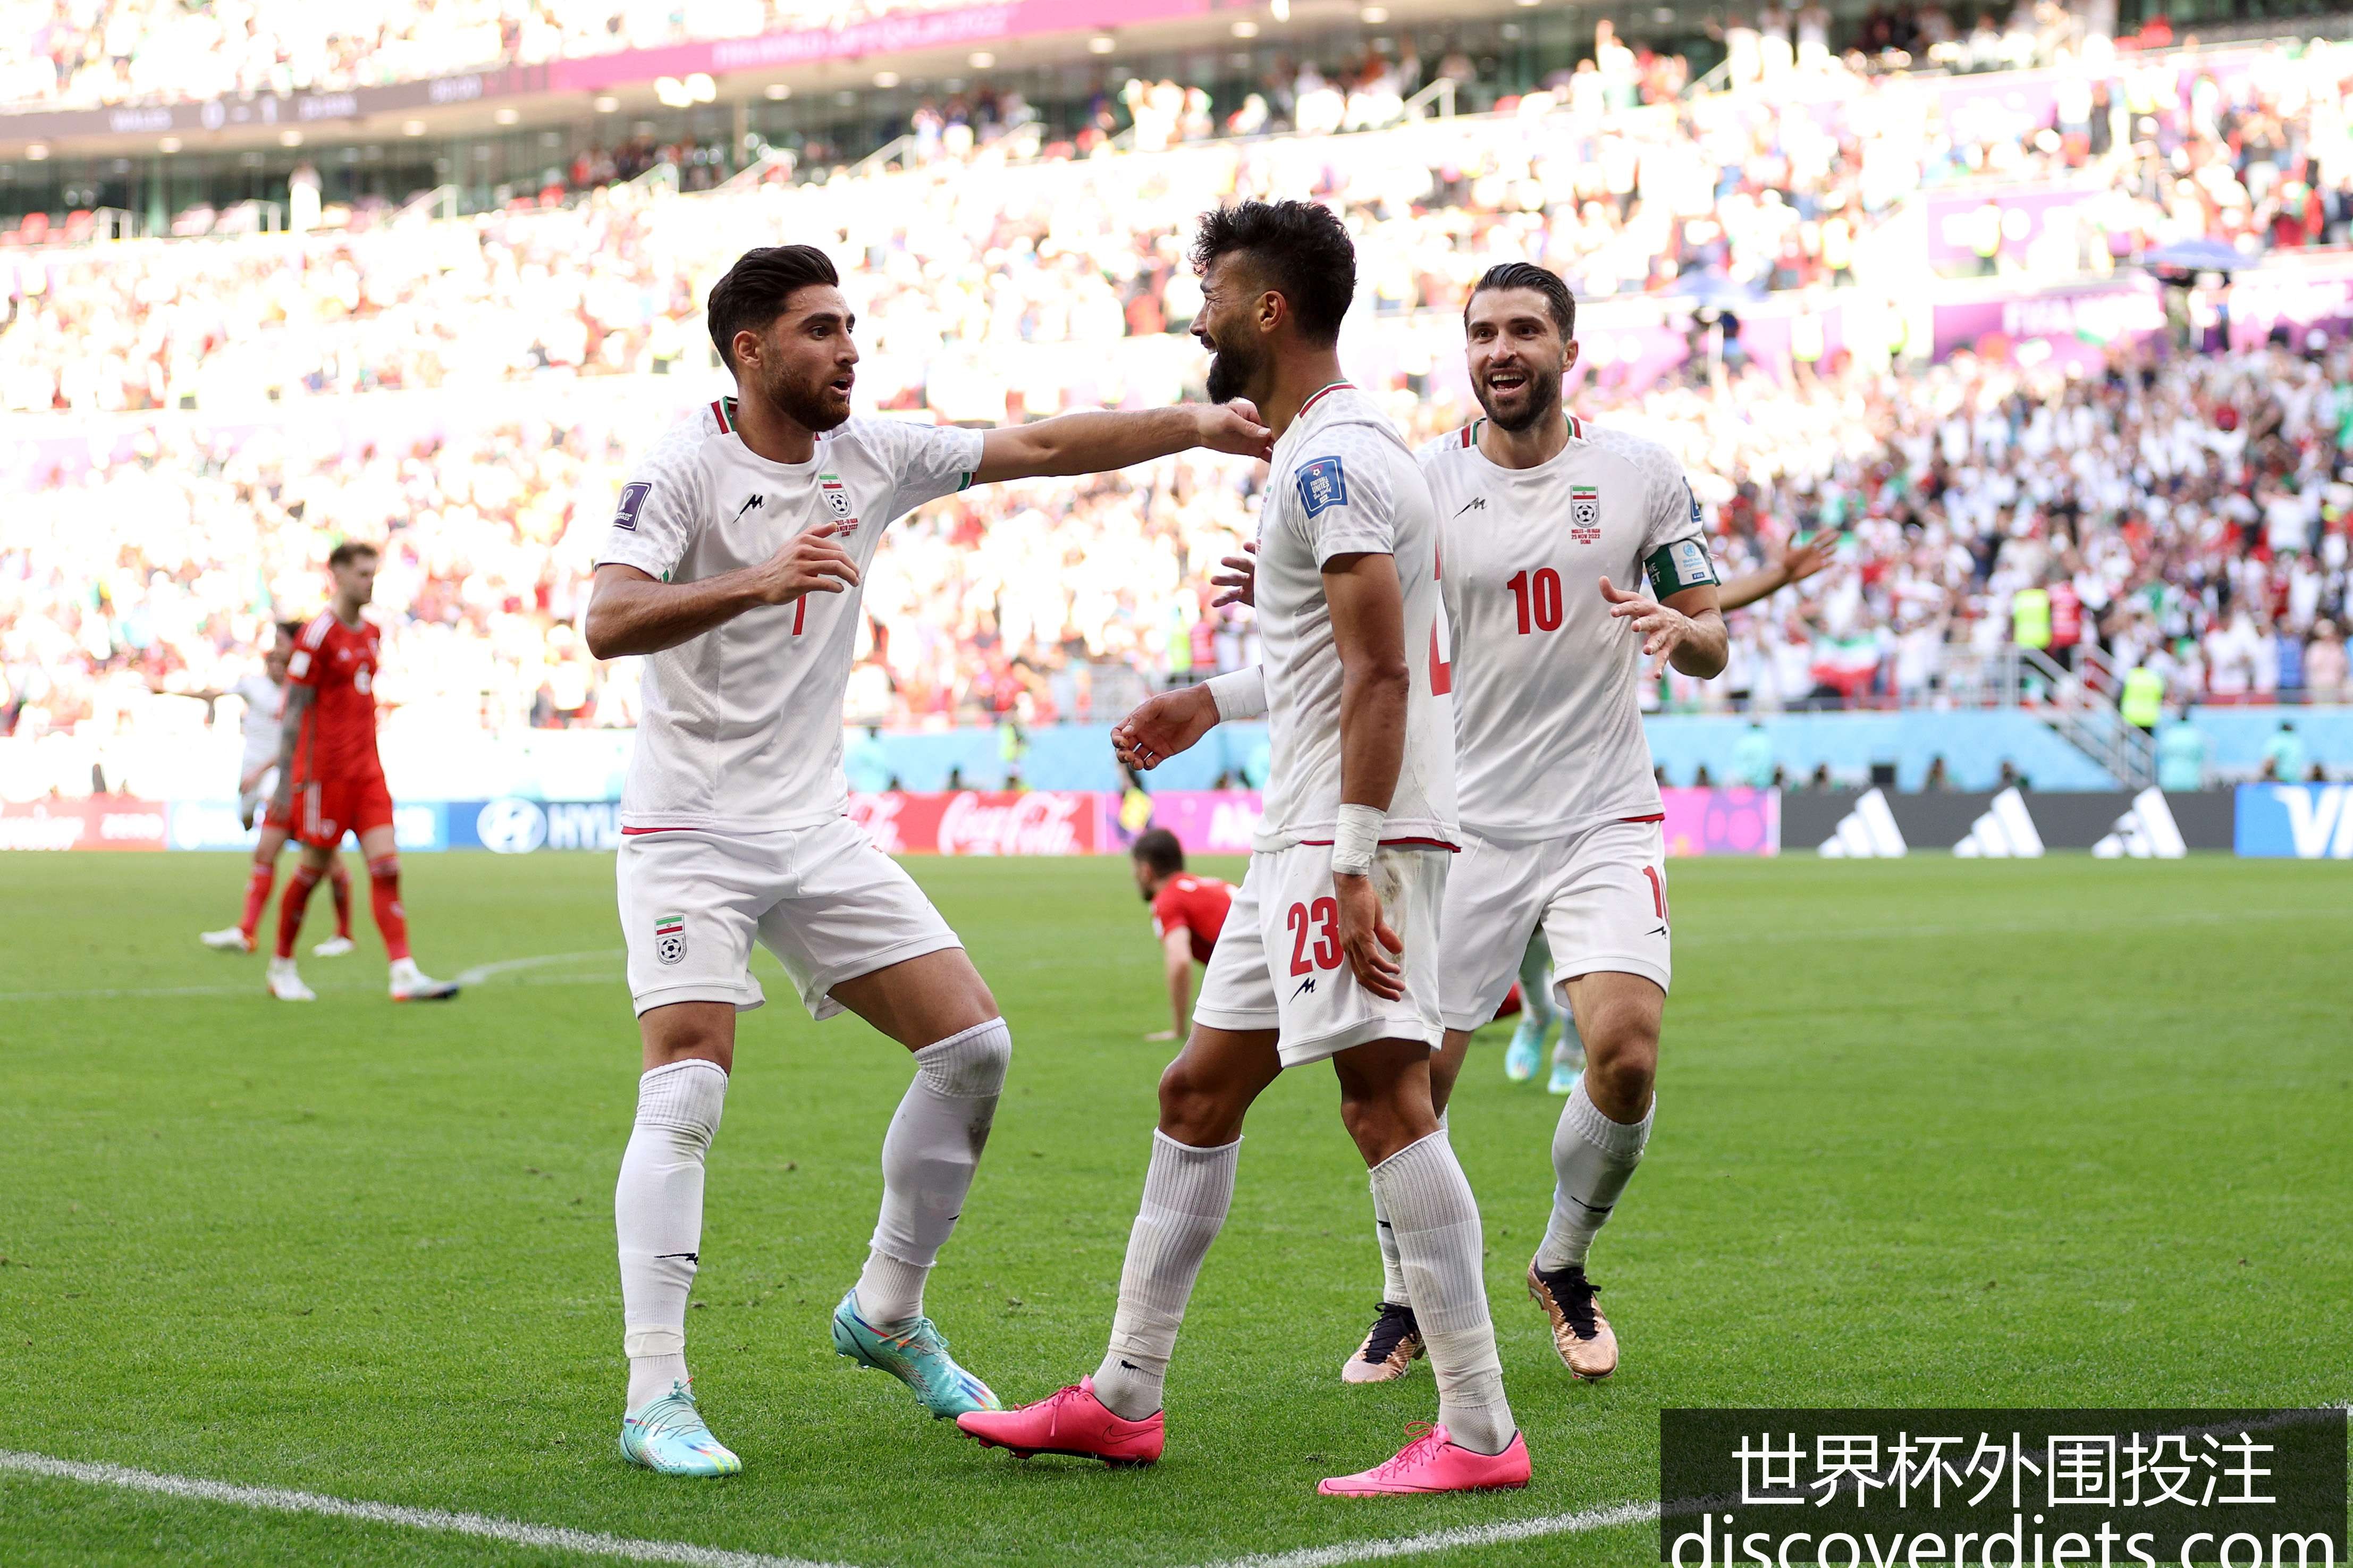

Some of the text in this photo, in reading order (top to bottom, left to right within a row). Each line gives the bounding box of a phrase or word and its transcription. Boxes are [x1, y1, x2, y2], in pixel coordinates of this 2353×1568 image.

[1312, 480, 1329, 493] UNITES
[1507, 568, 1563, 634] 10
[1287, 897, 1344, 977] 23
